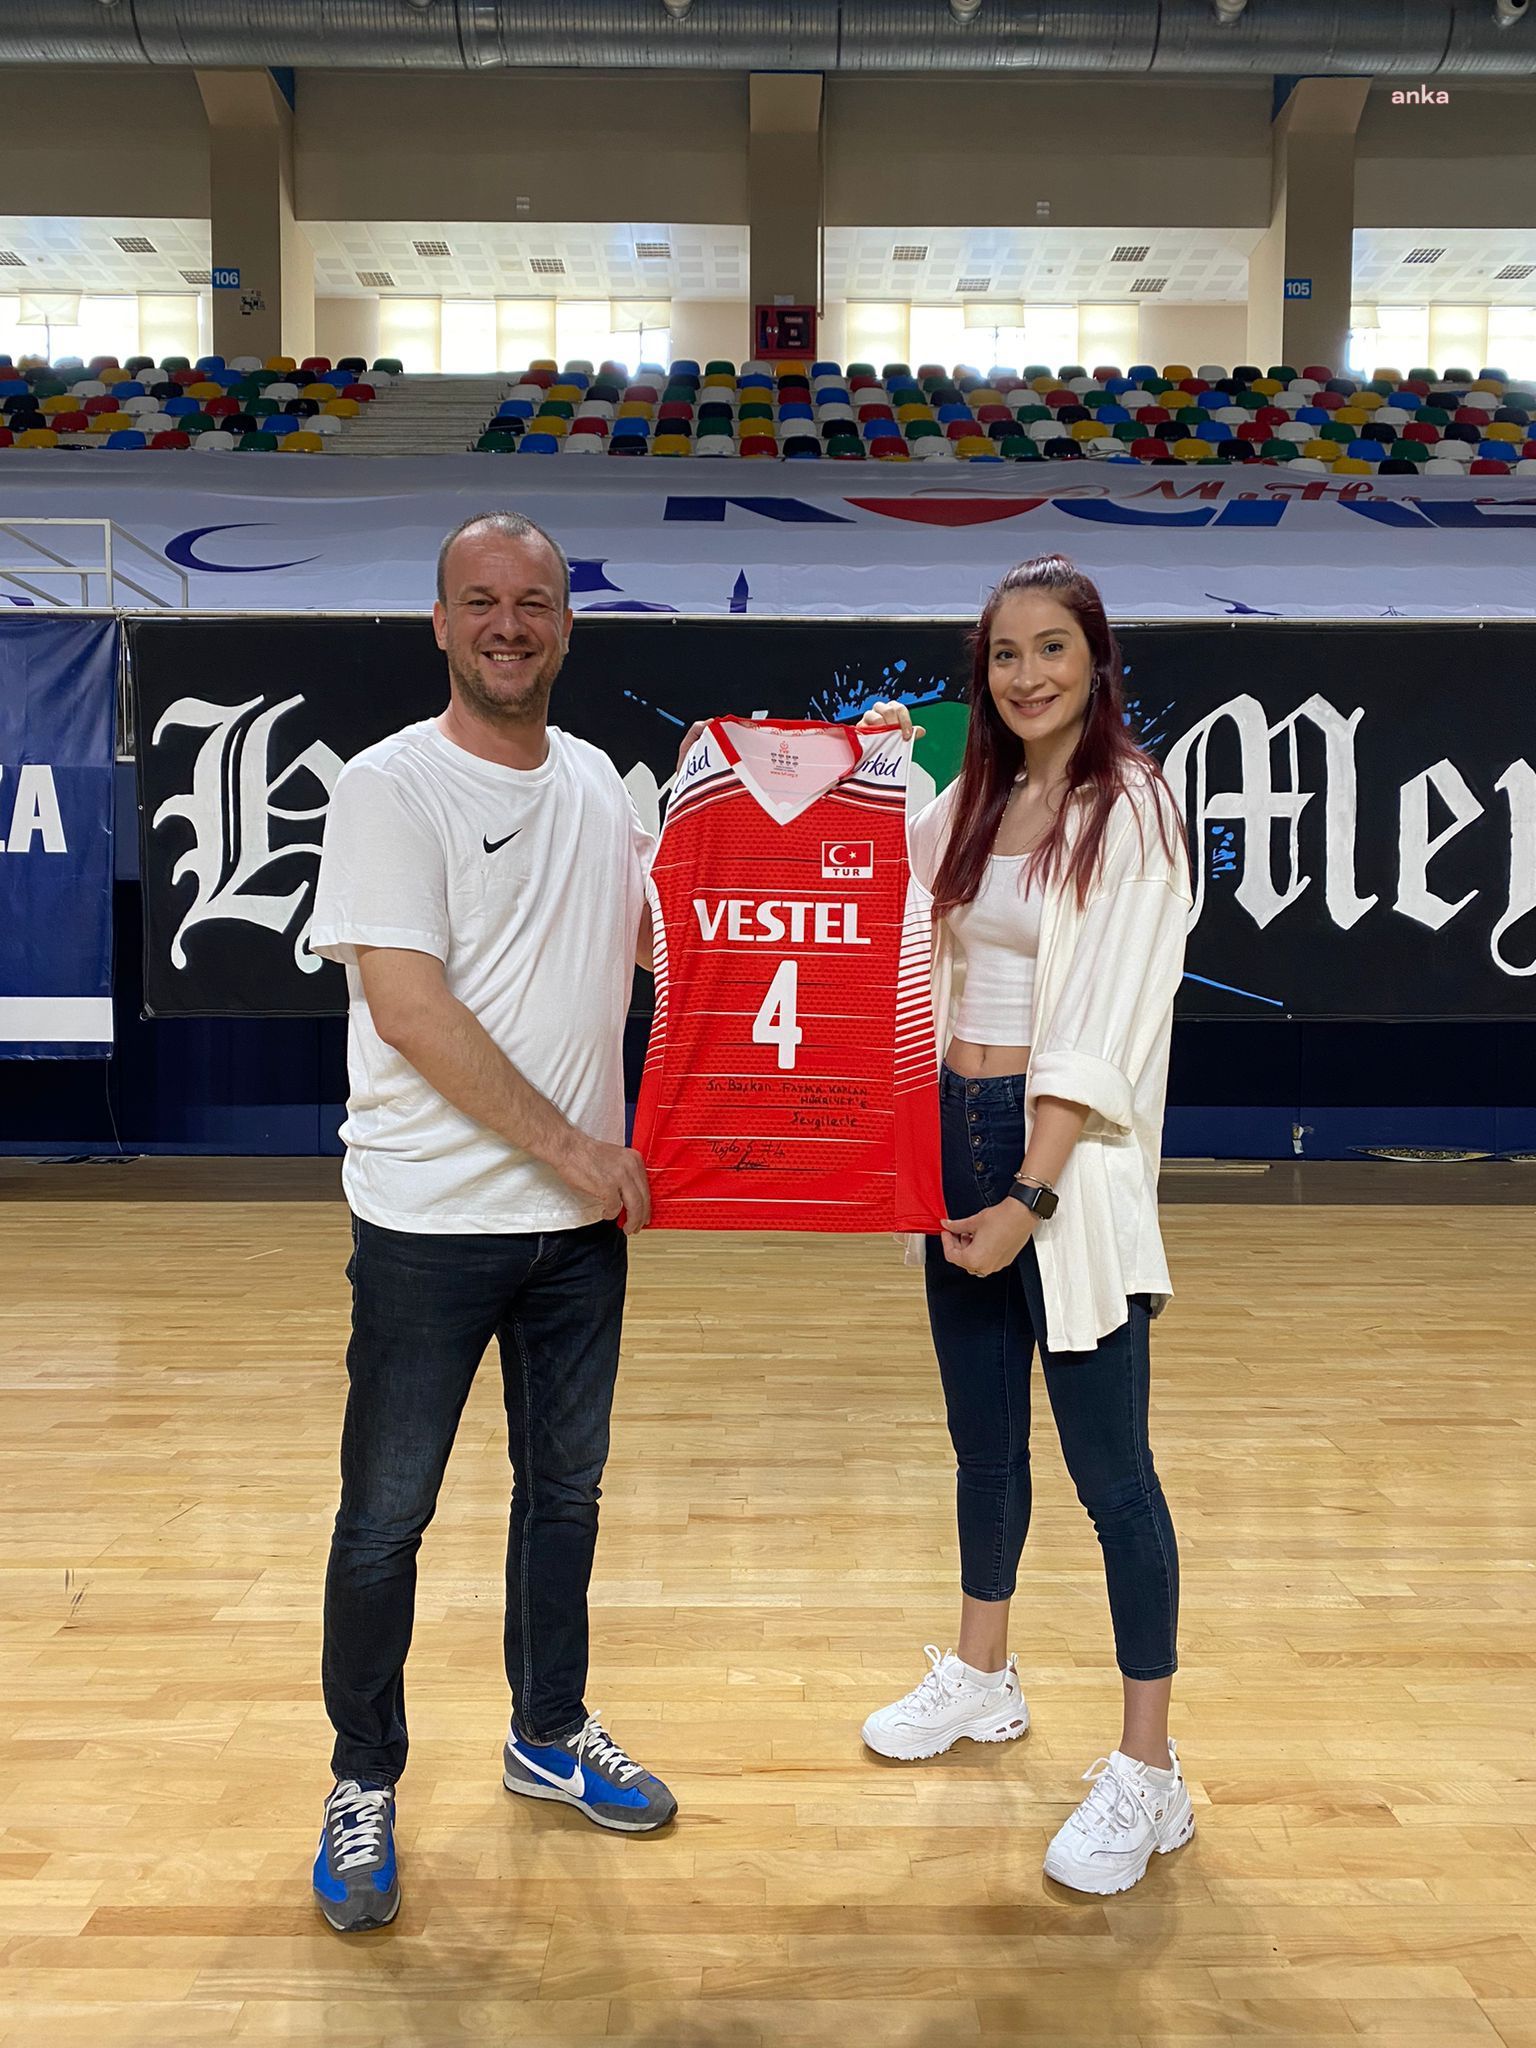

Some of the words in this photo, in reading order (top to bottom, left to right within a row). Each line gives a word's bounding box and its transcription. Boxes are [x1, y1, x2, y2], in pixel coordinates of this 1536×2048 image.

[214, 271, 239, 285] 106
[1286, 282, 1310, 296] 105
[0, 765, 68, 853] A
[833, 868, 860, 876] TUR
[692, 898, 872, 944] VESTEL
[752, 960, 802, 1070] 4
